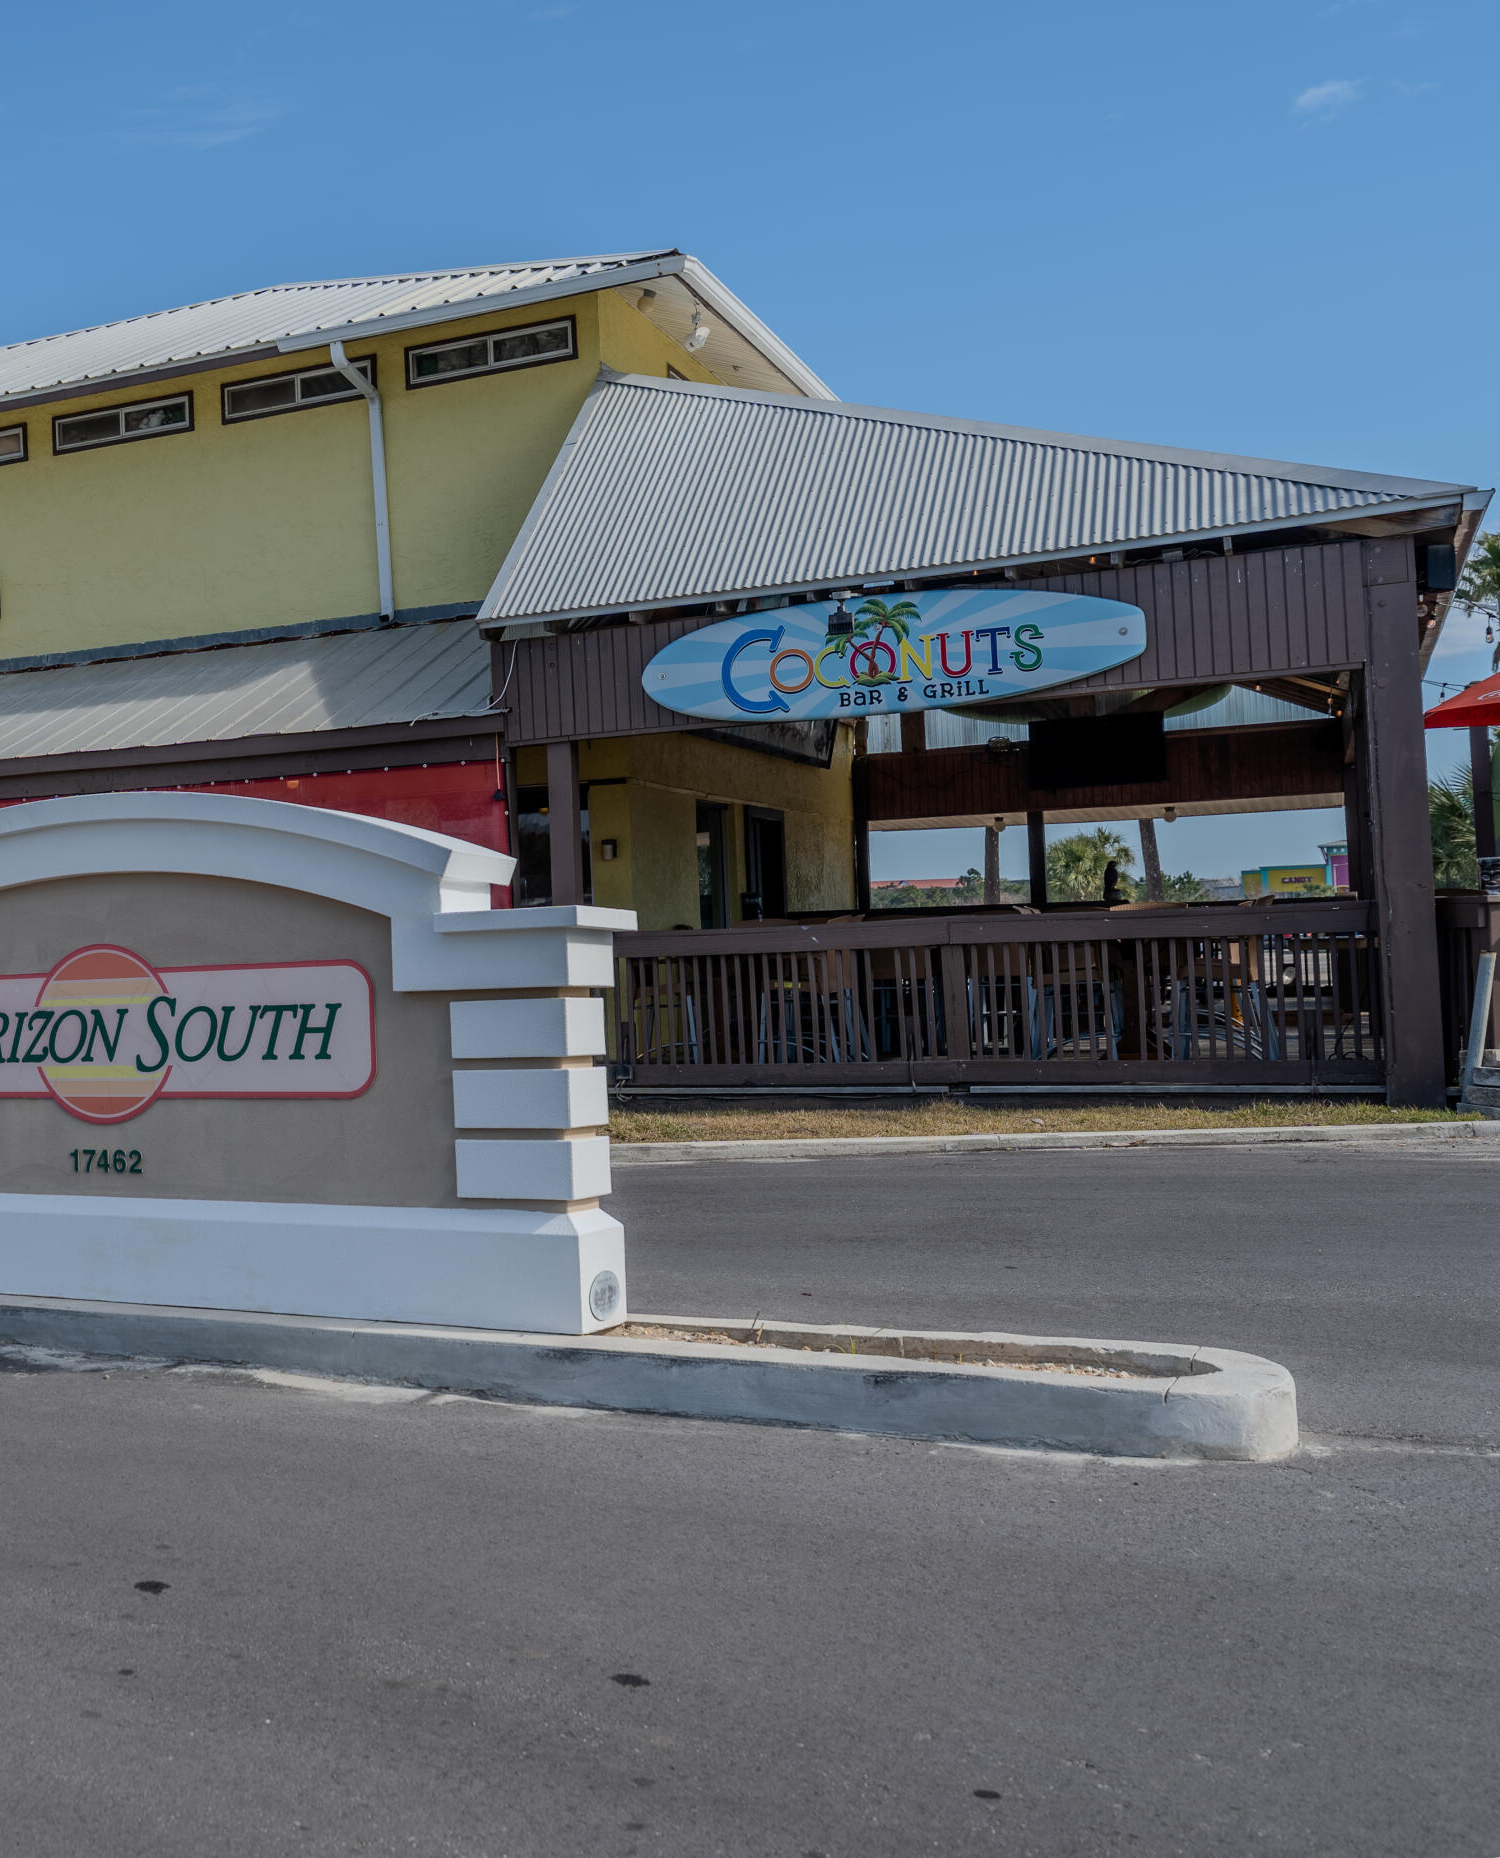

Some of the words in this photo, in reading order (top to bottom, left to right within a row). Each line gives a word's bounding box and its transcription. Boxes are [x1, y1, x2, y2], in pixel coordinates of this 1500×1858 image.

[722, 623, 1044, 714] COCONUTS
[897, 686, 909, 702] &
[135, 996, 342, 1073] SOUTH
[69, 1148, 143, 1174] 17462
